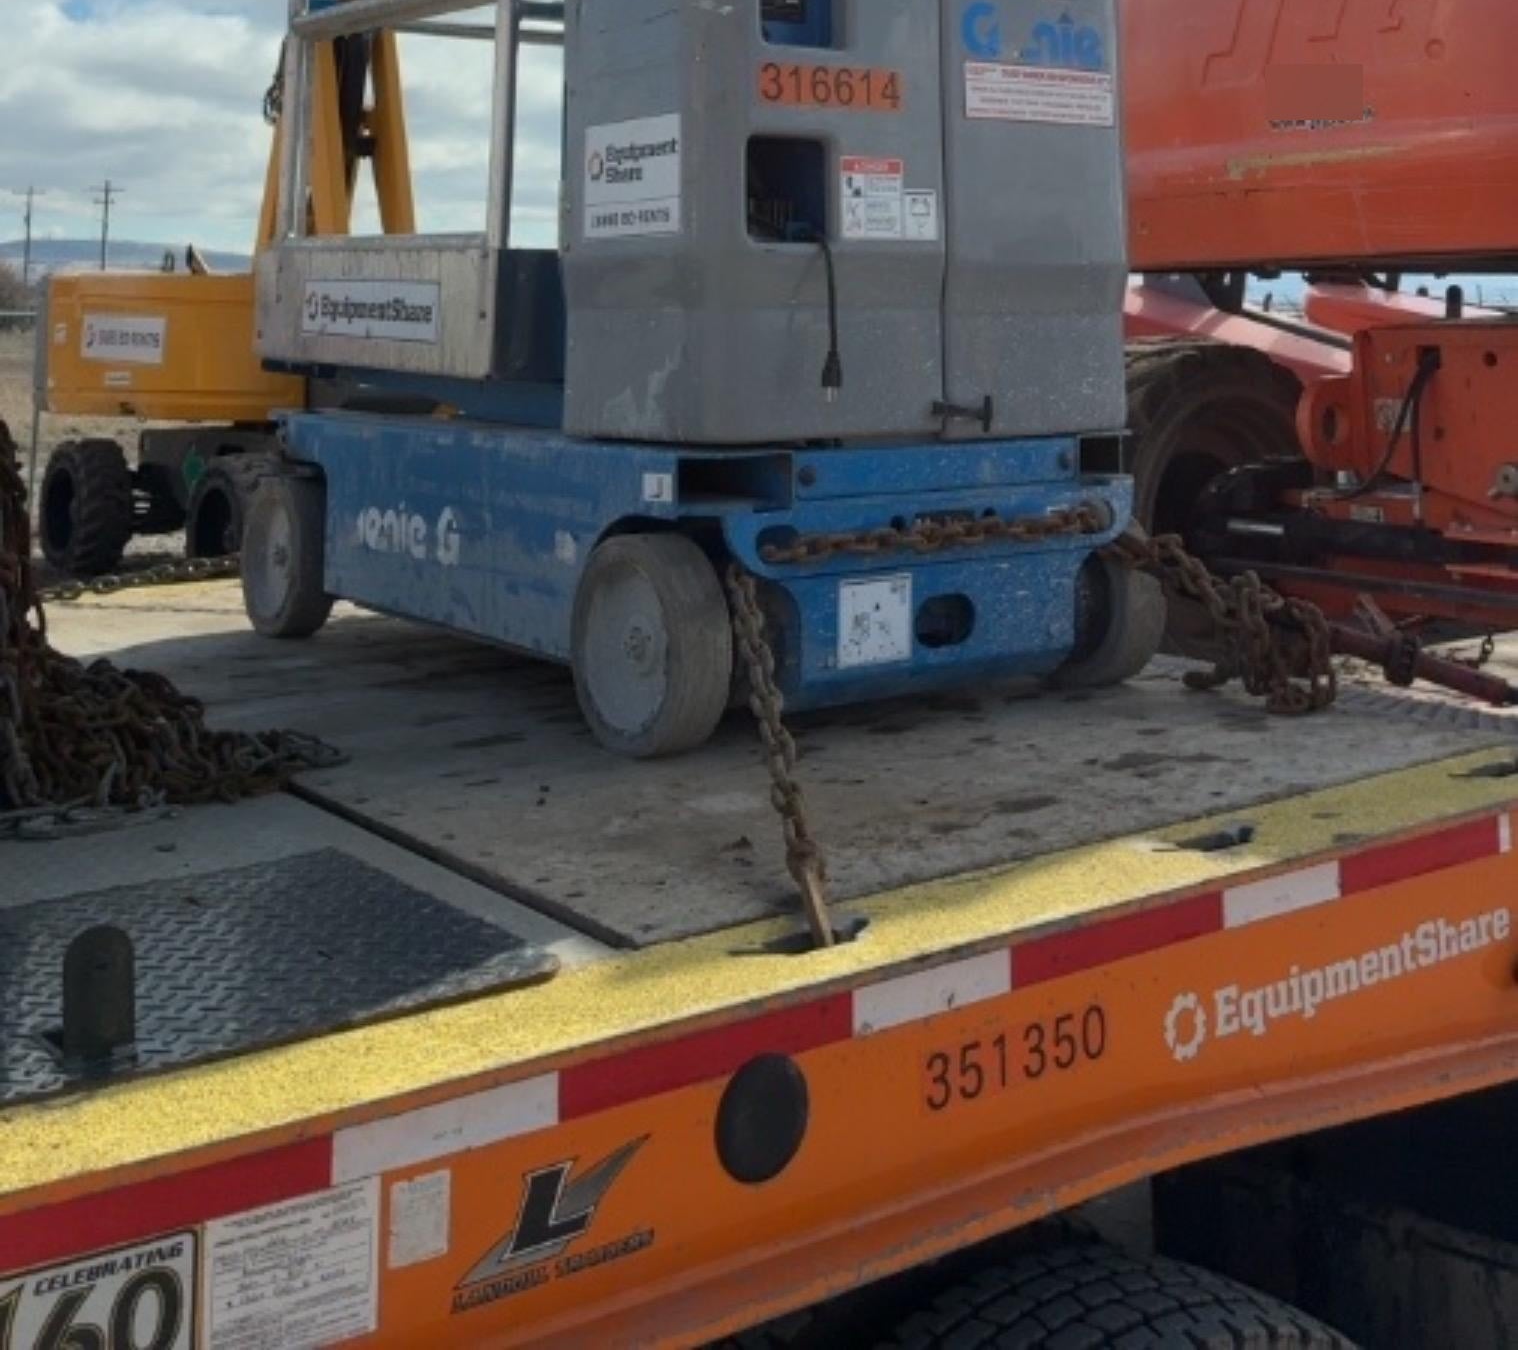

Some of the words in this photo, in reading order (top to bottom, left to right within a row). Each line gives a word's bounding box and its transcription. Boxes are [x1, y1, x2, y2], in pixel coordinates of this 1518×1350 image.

[761, 61, 902, 109] 316614
[320, 293, 433, 324] EquipmentShare
[1213, 905, 1511, 1039] EquipmentShare
[925, 1004, 1107, 1111] 351350
[34, 1240, 184, 1296] CELEBRATING
